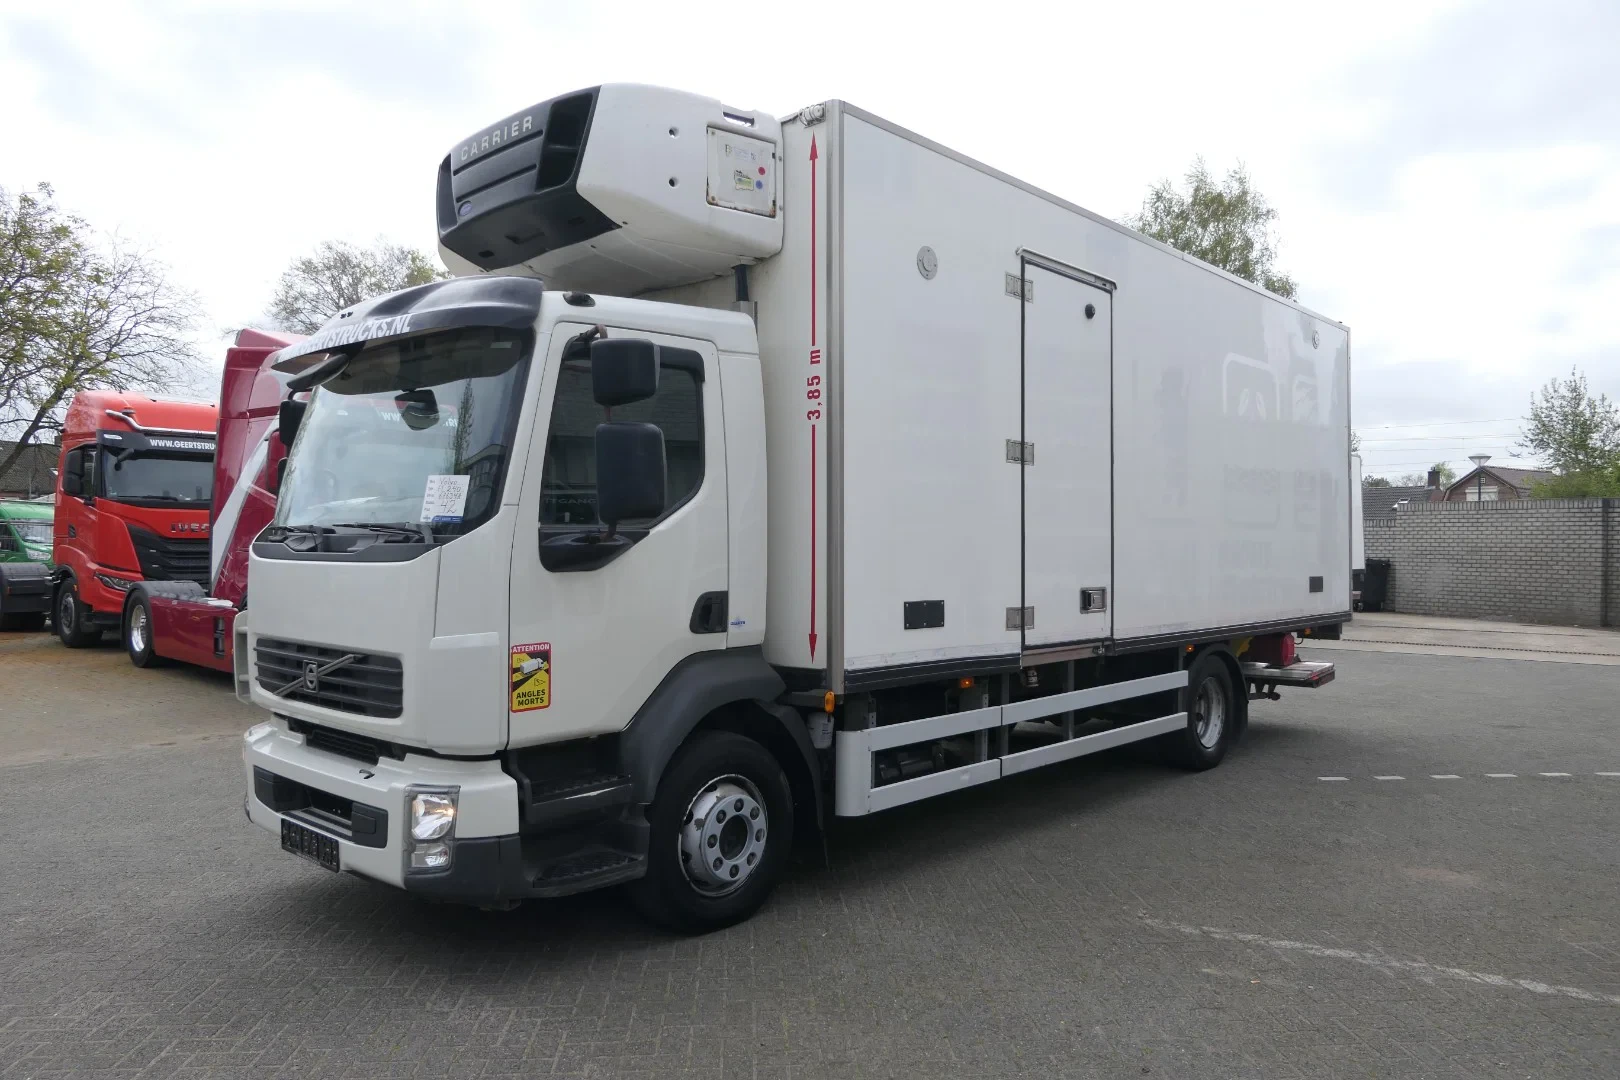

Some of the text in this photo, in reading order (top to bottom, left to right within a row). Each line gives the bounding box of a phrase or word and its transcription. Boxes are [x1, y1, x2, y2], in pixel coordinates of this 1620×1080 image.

[461, 115, 533, 161] CARRIER
[806, 349, 823, 421] 3,85 m
[149, 438, 217, 451] WWW.GEERTSTRU
[512, 643, 550, 653] ATTENTION
[515, 688, 546, 700] ANGLES
[517, 696, 545, 707] MORTS
